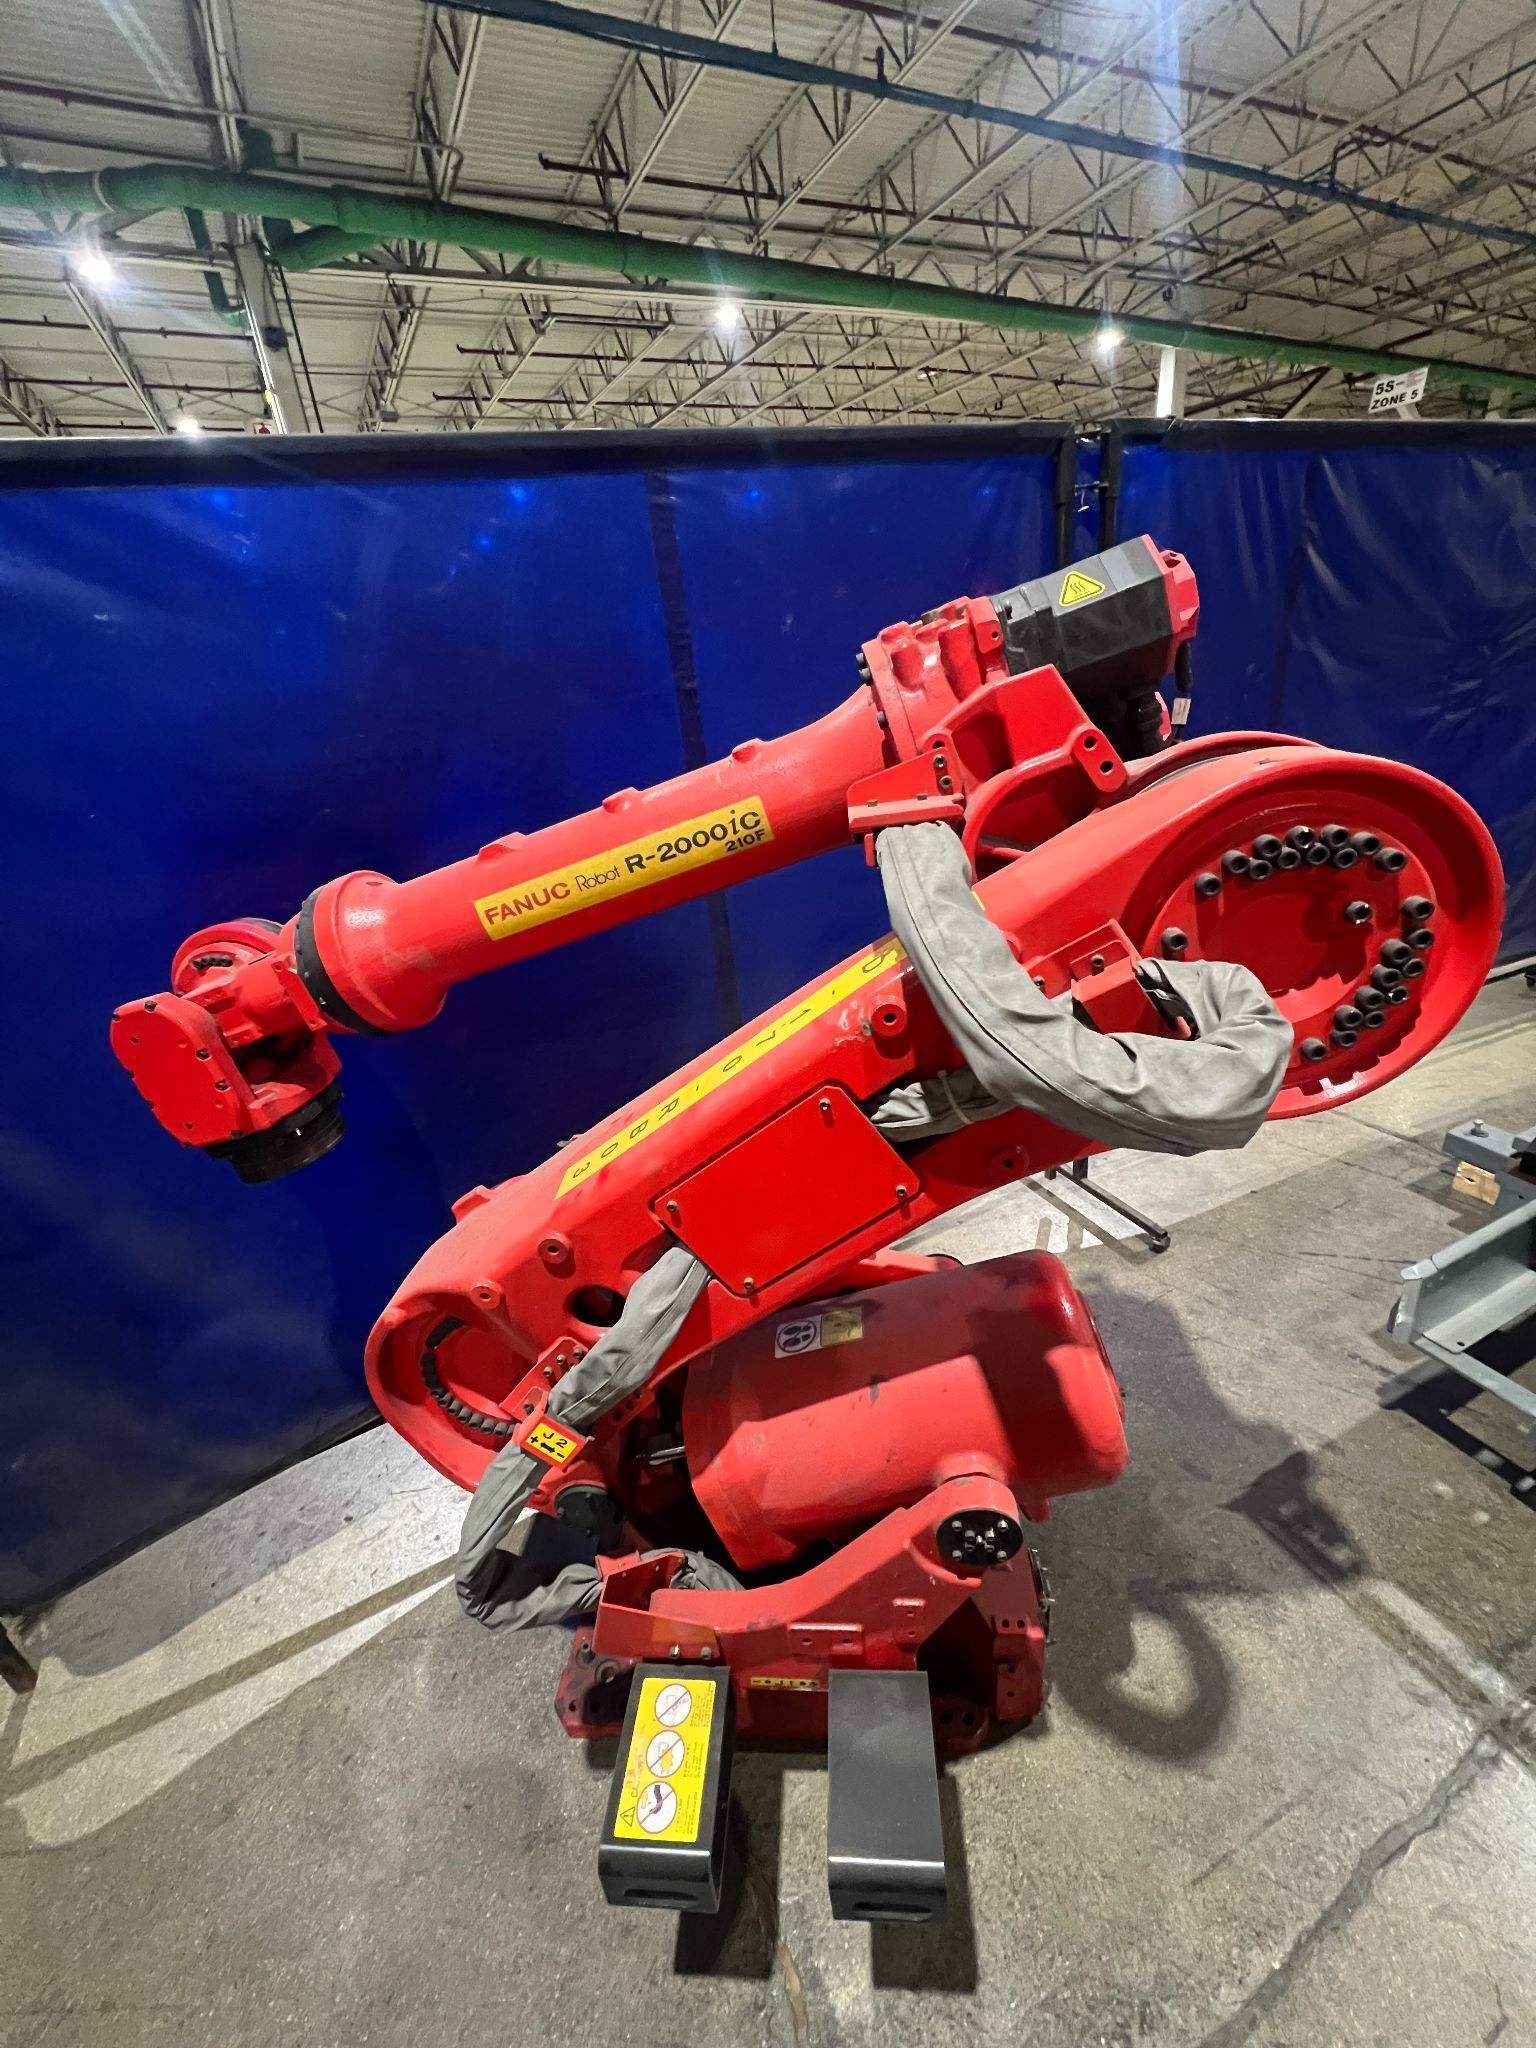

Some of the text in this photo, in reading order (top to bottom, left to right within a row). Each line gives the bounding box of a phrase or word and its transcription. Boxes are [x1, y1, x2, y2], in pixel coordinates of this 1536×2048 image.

[1375, 380, 1405, 396] 5S-
[1371, 389, 1418, 410] ZONE 5
[725, 828, 766, 852] 210F
[484, 809, 761, 925] FANUC Robot R-2000iC
